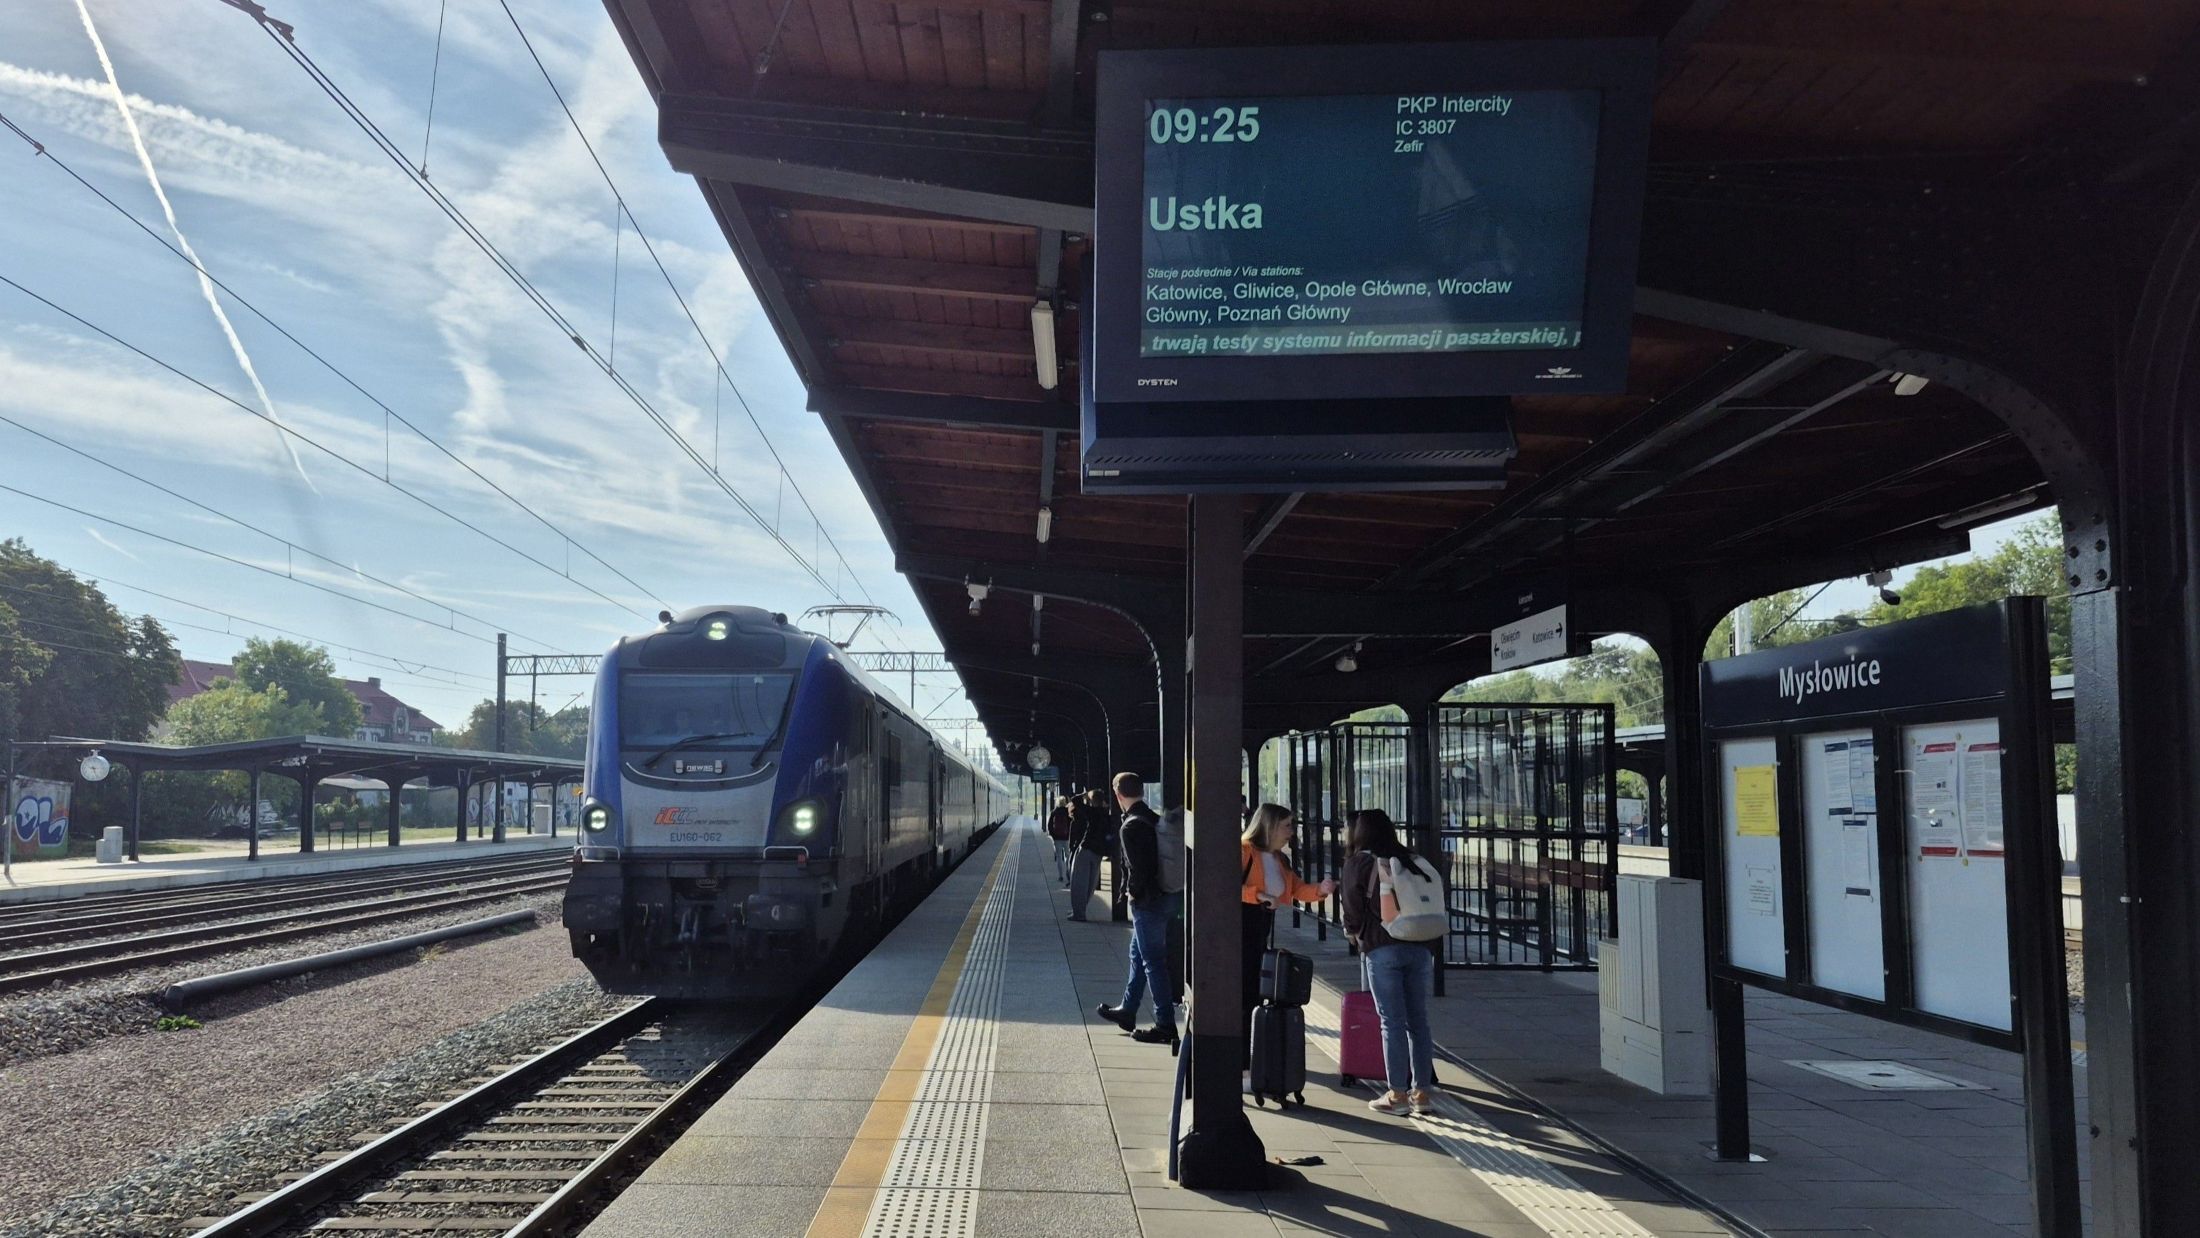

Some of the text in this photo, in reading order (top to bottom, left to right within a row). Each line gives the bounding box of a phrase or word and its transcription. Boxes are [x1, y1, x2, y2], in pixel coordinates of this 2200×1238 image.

[1397, 95, 1513, 116] PKP Intercity
[1150, 107, 1260, 144] 09:25
[1396, 119, 1457, 135] IC 3807
[1394, 140, 1425, 153] Zefir
[1149, 195, 1263, 231] Ustka
[1147, 266, 1305, 280] Stacje pośrednie / Via stations:
[1146, 278, 1512, 302] Katowice, Gliwice, Opole Główne, Wrocław
[1145, 304, 1351, 326] Główny, Poznań Główny
[1152, 334, 1208, 354] trwają
[1213, 334, 1259, 353] testy
[1263, 333, 1342, 353] systemu
[1346, 330, 1442, 350] informacji
[1444, 327, 1568, 348] pasażerskiej,
[1137, 378, 1178, 386] DYSTEN
[1779, 654, 1880, 704] Mysłowice
